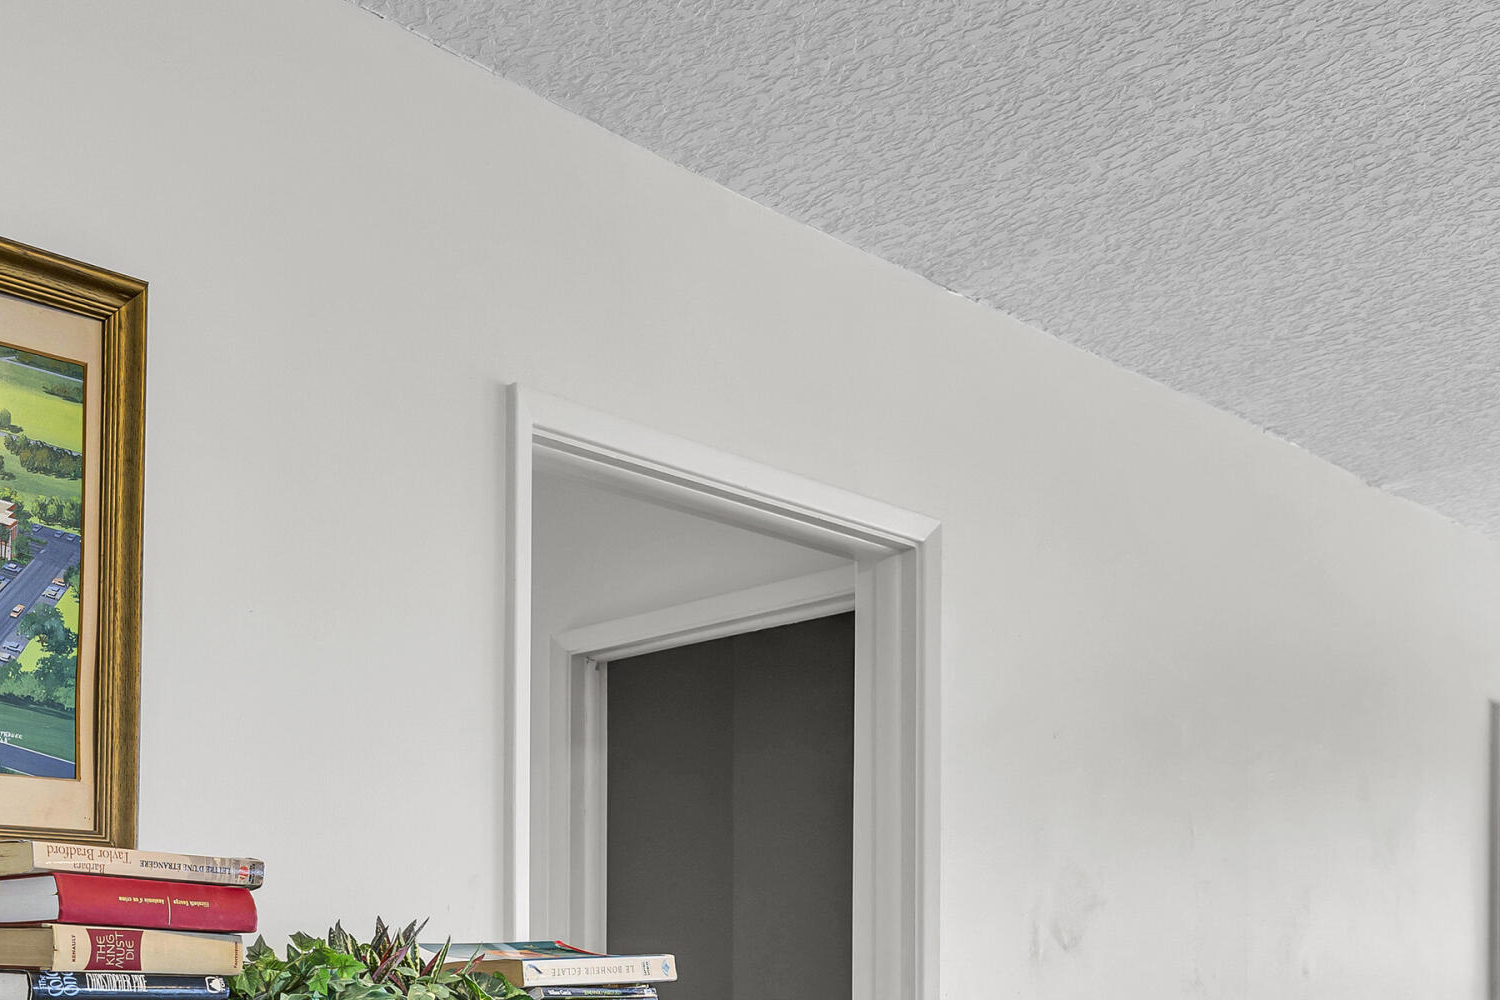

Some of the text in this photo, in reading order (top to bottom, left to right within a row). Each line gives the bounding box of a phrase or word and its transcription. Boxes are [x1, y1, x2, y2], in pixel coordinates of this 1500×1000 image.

[47, 845, 131, 864] Taylor Bradford
[72, 863, 105, 873] Barbara
[96, 937, 105, 962] THE
[105, 931, 114, 966] KING
[115, 931, 124, 969] MUST
[126, 940, 134, 959] DIE
[584, 966, 622, 975] BONHEUR
[625, 965, 634, 973] LE
